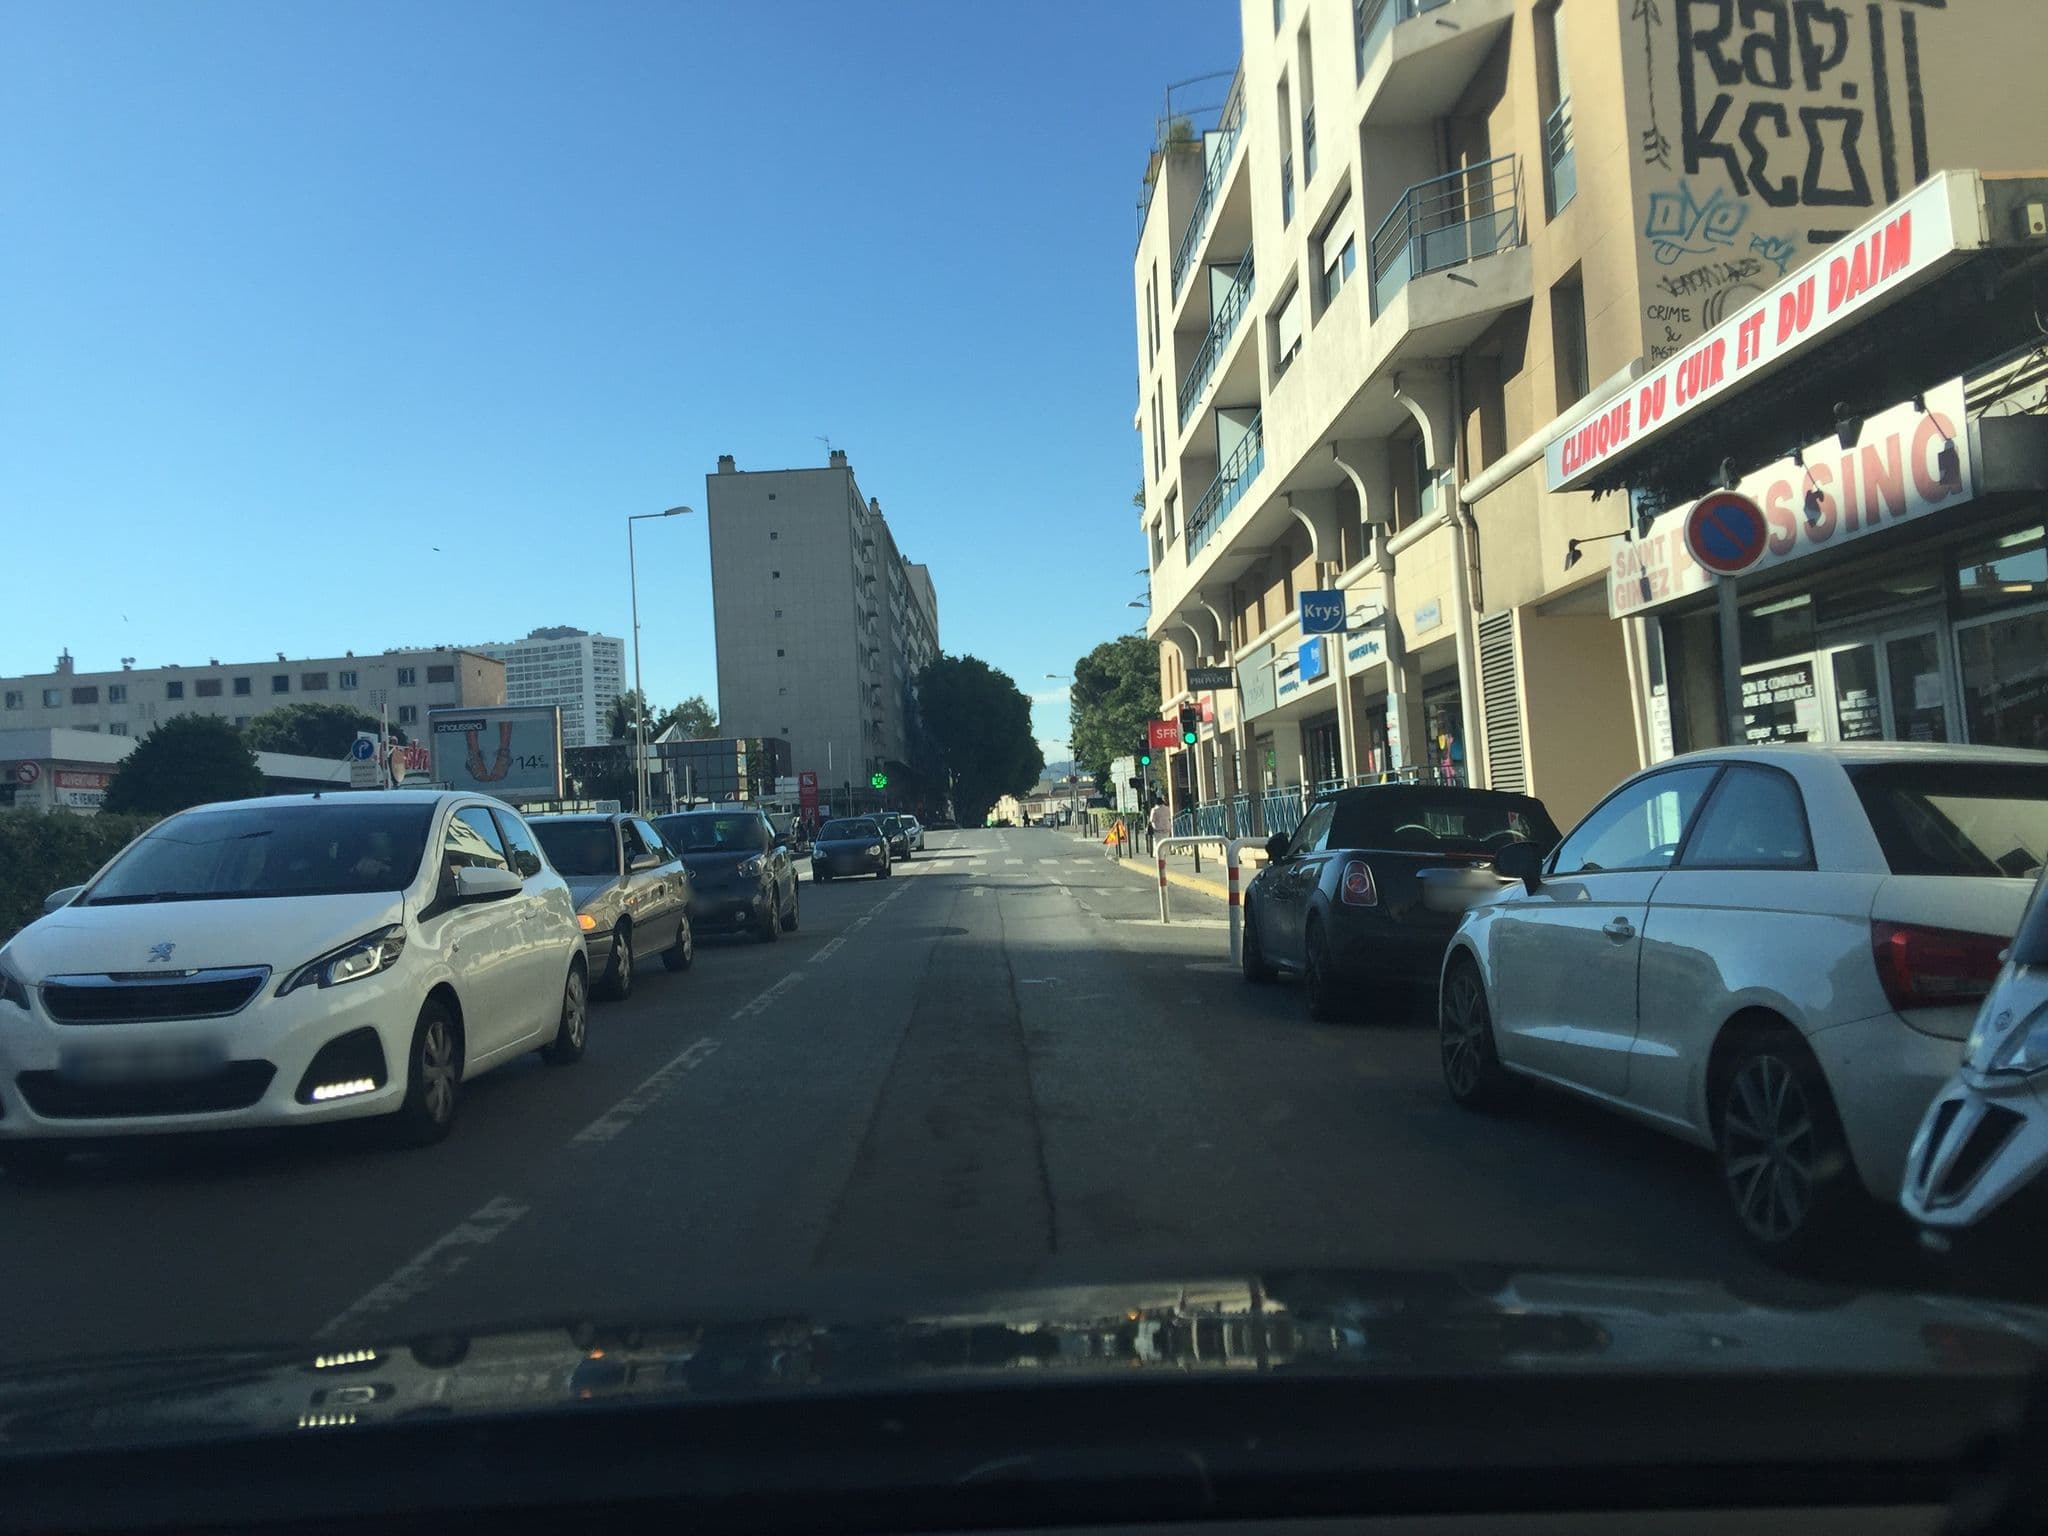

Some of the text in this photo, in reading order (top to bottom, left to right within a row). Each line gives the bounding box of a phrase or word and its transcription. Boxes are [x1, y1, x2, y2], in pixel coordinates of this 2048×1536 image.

[1647, 304, 1691, 323] CRIME
[1562, 398, 1631, 477] CLINIQUE
[1639, 374, 1666, 430] DU
[1676, 338, 1726, 407] CUIR
[1736, 308, 1766, 370] ET
[1776, 273, 1816, 347] DU
[1828, 209, 1912, 314] DAIM
[1616, 534, 1665, 579] SAINT
[1304, 604, 1341, 621] Krys
[1156, 729, 1178, 740] SFR
